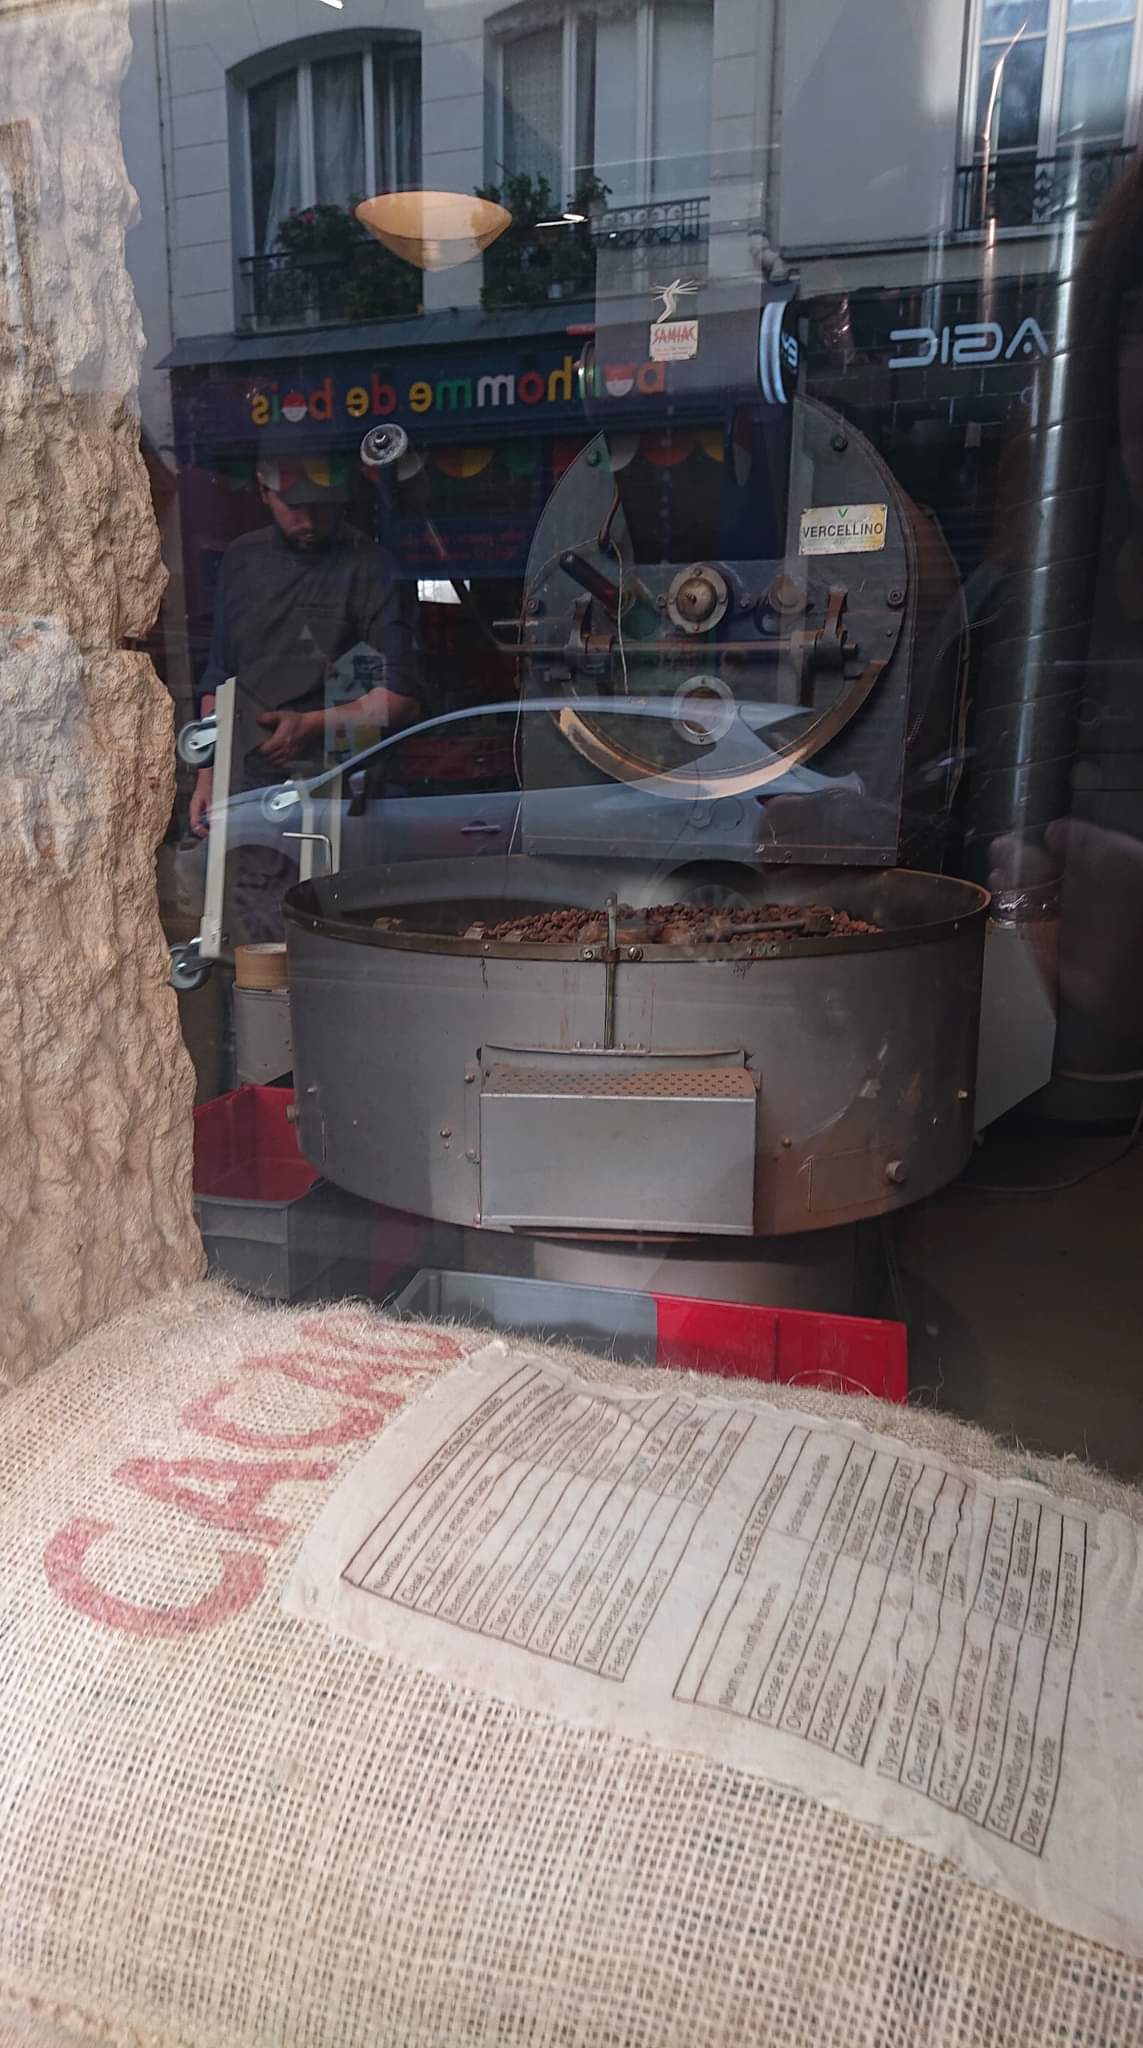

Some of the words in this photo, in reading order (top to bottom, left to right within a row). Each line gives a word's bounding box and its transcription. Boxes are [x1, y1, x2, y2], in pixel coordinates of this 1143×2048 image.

[803, 522, 883, 538] VERCELLINO
[43, 1313, 466, 1639] CACAO
[733, 1532, 758, 1576] FICHE
[751, 1471, 786, 1531] TECHNIQUE
[791, 1611, 808, 1631] de
[780, 1629, 804, 1660] type
[775, 1659, 790, 1676] et
[755, 1673, 785, 1721] Classe
[784, 1677, 818, 1732] Origine
[951, 1682, 975, 1737] Nombre
[887, 1714, 905, 1734] de
[1014, 1711, 1030, 1735] par
[877, 1735, 903, 1773] Type
[905, 1720, 934, 1786] Quantité
[1035, 1734, 1056, 1783] récolte
[960, 1778, 984, 1816] Date
[973, 1760, 992, 1780] et
[1030, 1785, 1047, 1807] de
[1018, 1806, 1040, 1846] Date
